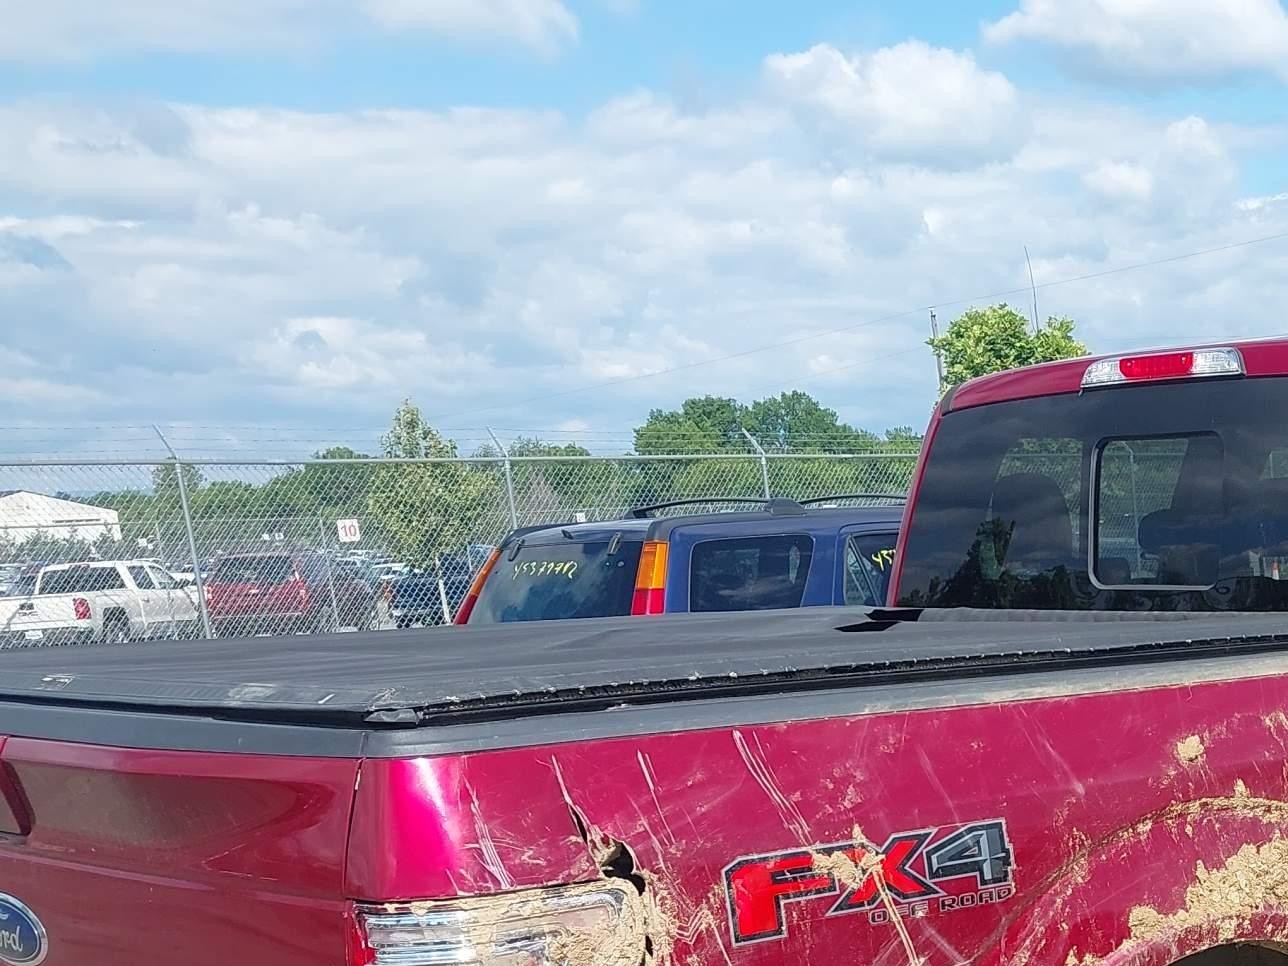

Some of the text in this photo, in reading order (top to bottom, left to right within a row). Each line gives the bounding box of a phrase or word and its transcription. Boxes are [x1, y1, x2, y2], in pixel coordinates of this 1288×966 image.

[340, 524, 357, 537] 10
[720, 817, 1014, 948] FX4
[869, 885, 1016, 925] OFF ROAD
